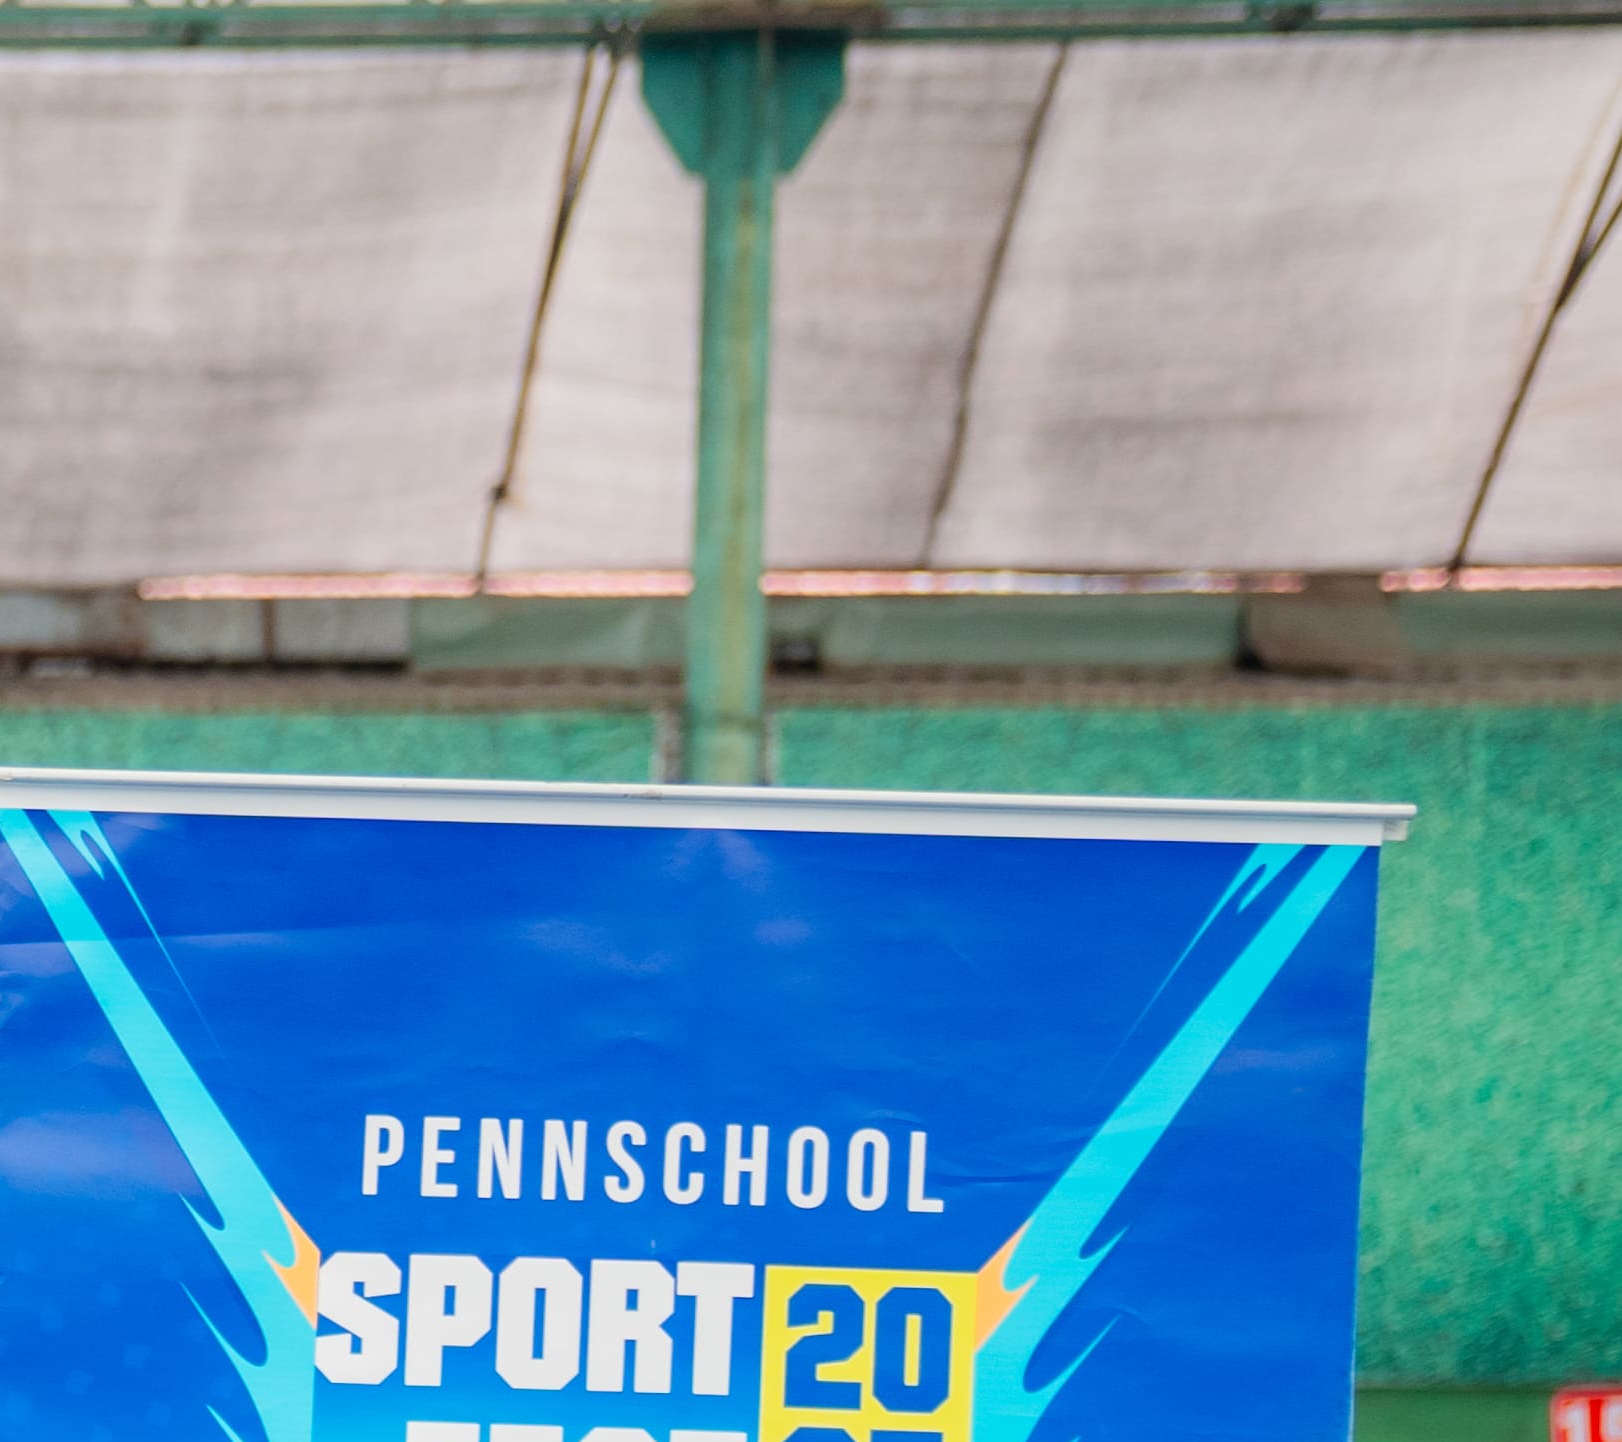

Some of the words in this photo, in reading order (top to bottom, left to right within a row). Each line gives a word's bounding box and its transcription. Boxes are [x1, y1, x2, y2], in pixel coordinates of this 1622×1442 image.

[362, 1113, 946, 1214] PENNSCHOOL
[316, 1252, 755, 1397] SPORT
[785, 1284, 954, 1413] 20
